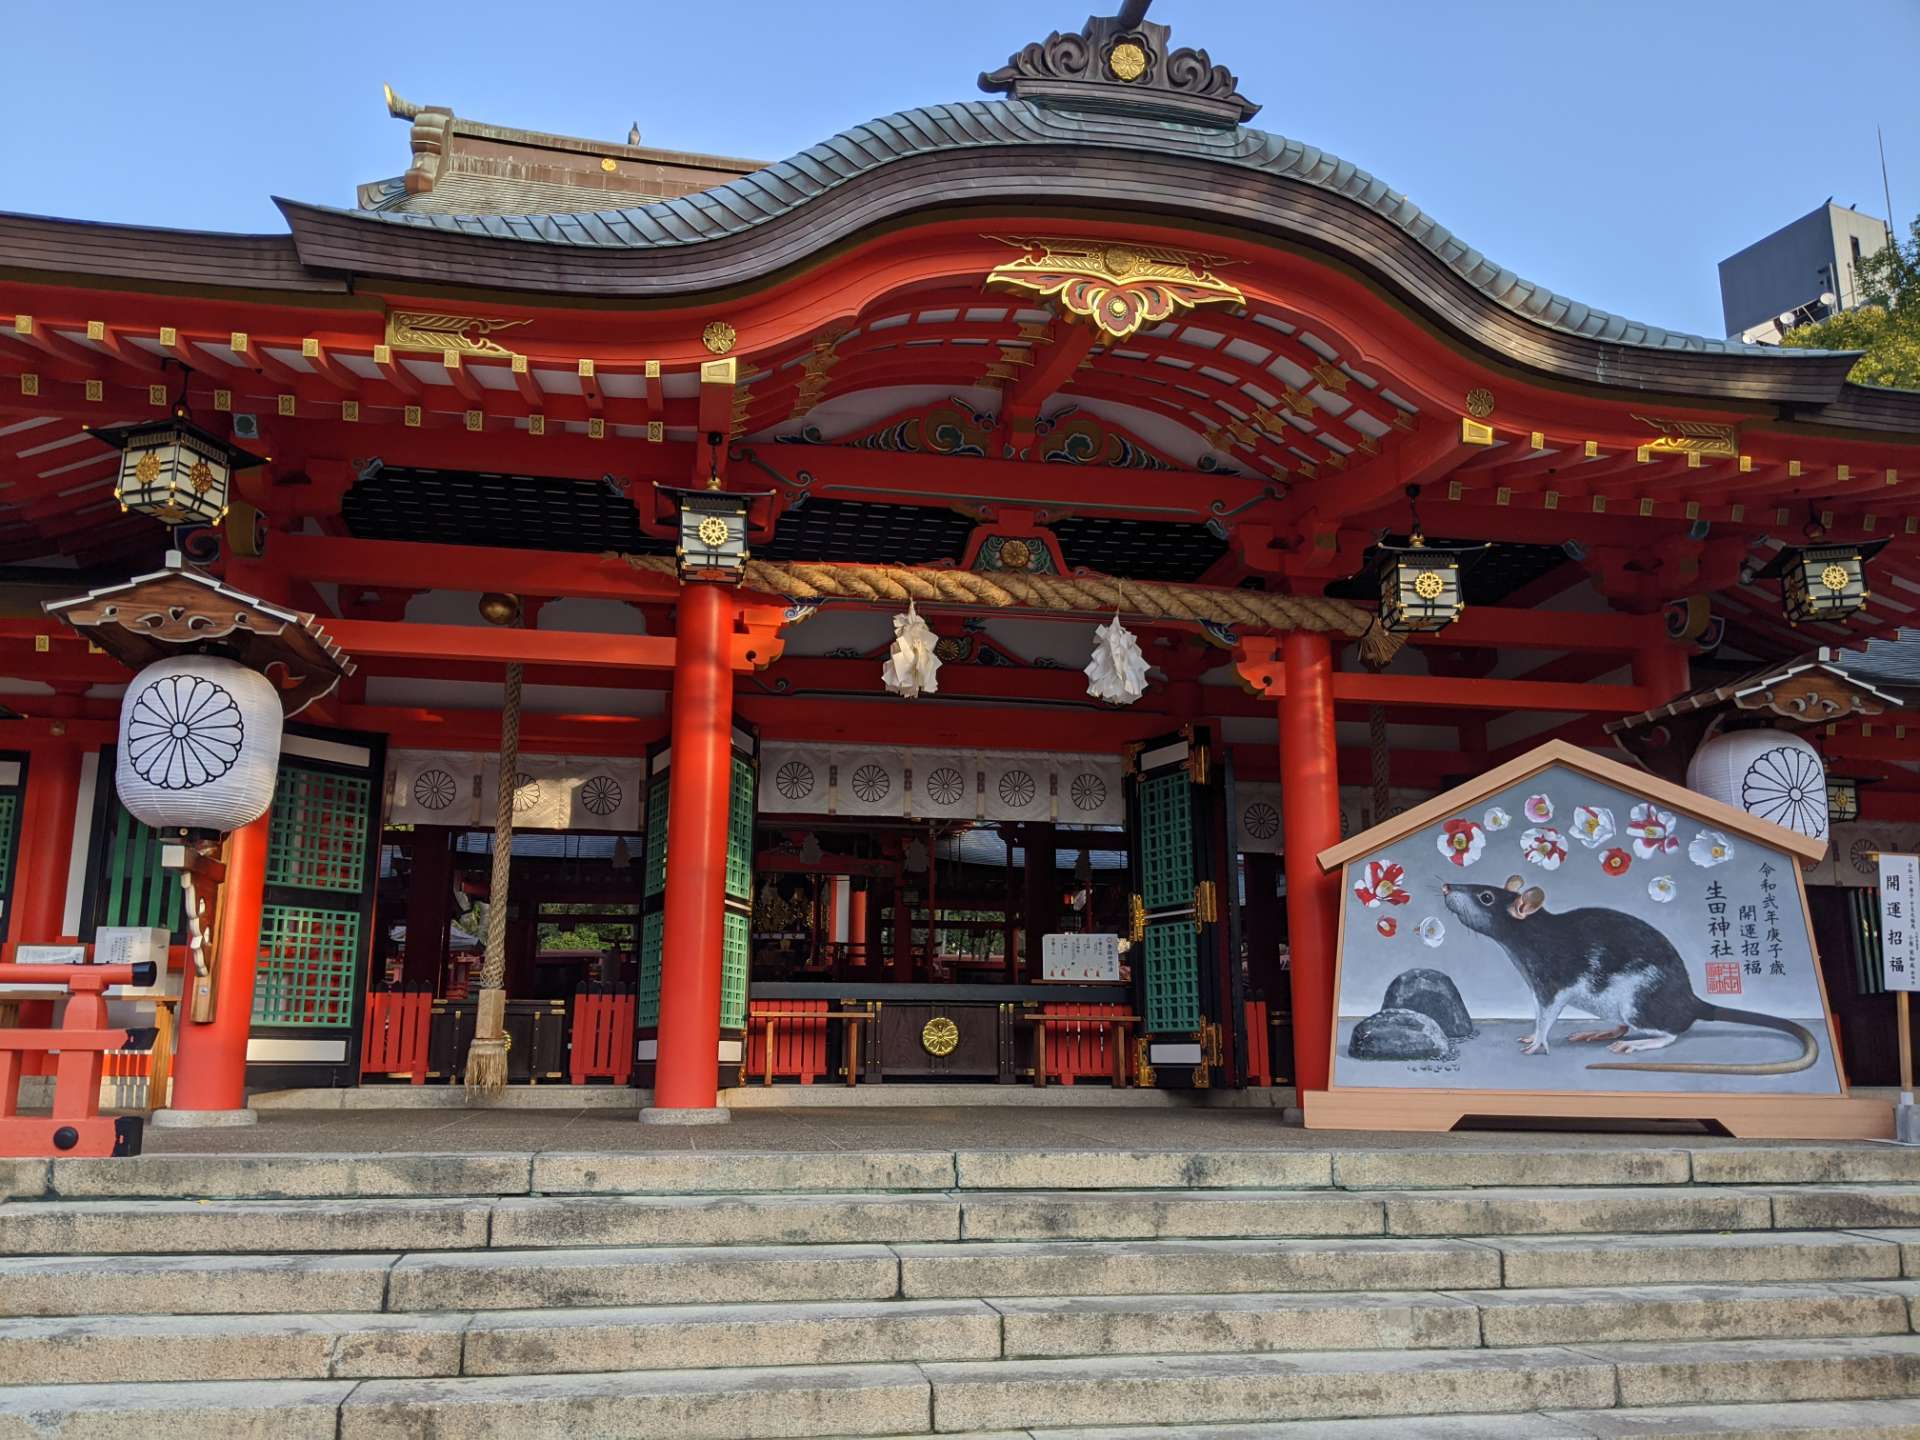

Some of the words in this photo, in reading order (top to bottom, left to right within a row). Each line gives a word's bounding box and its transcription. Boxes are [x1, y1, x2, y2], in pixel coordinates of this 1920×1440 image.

[1705, 880, 1734, 959] 生田神社
[1739, 905, 1762, 976] 開運招福
[1886, 874, 1904, 973] 開運招福
